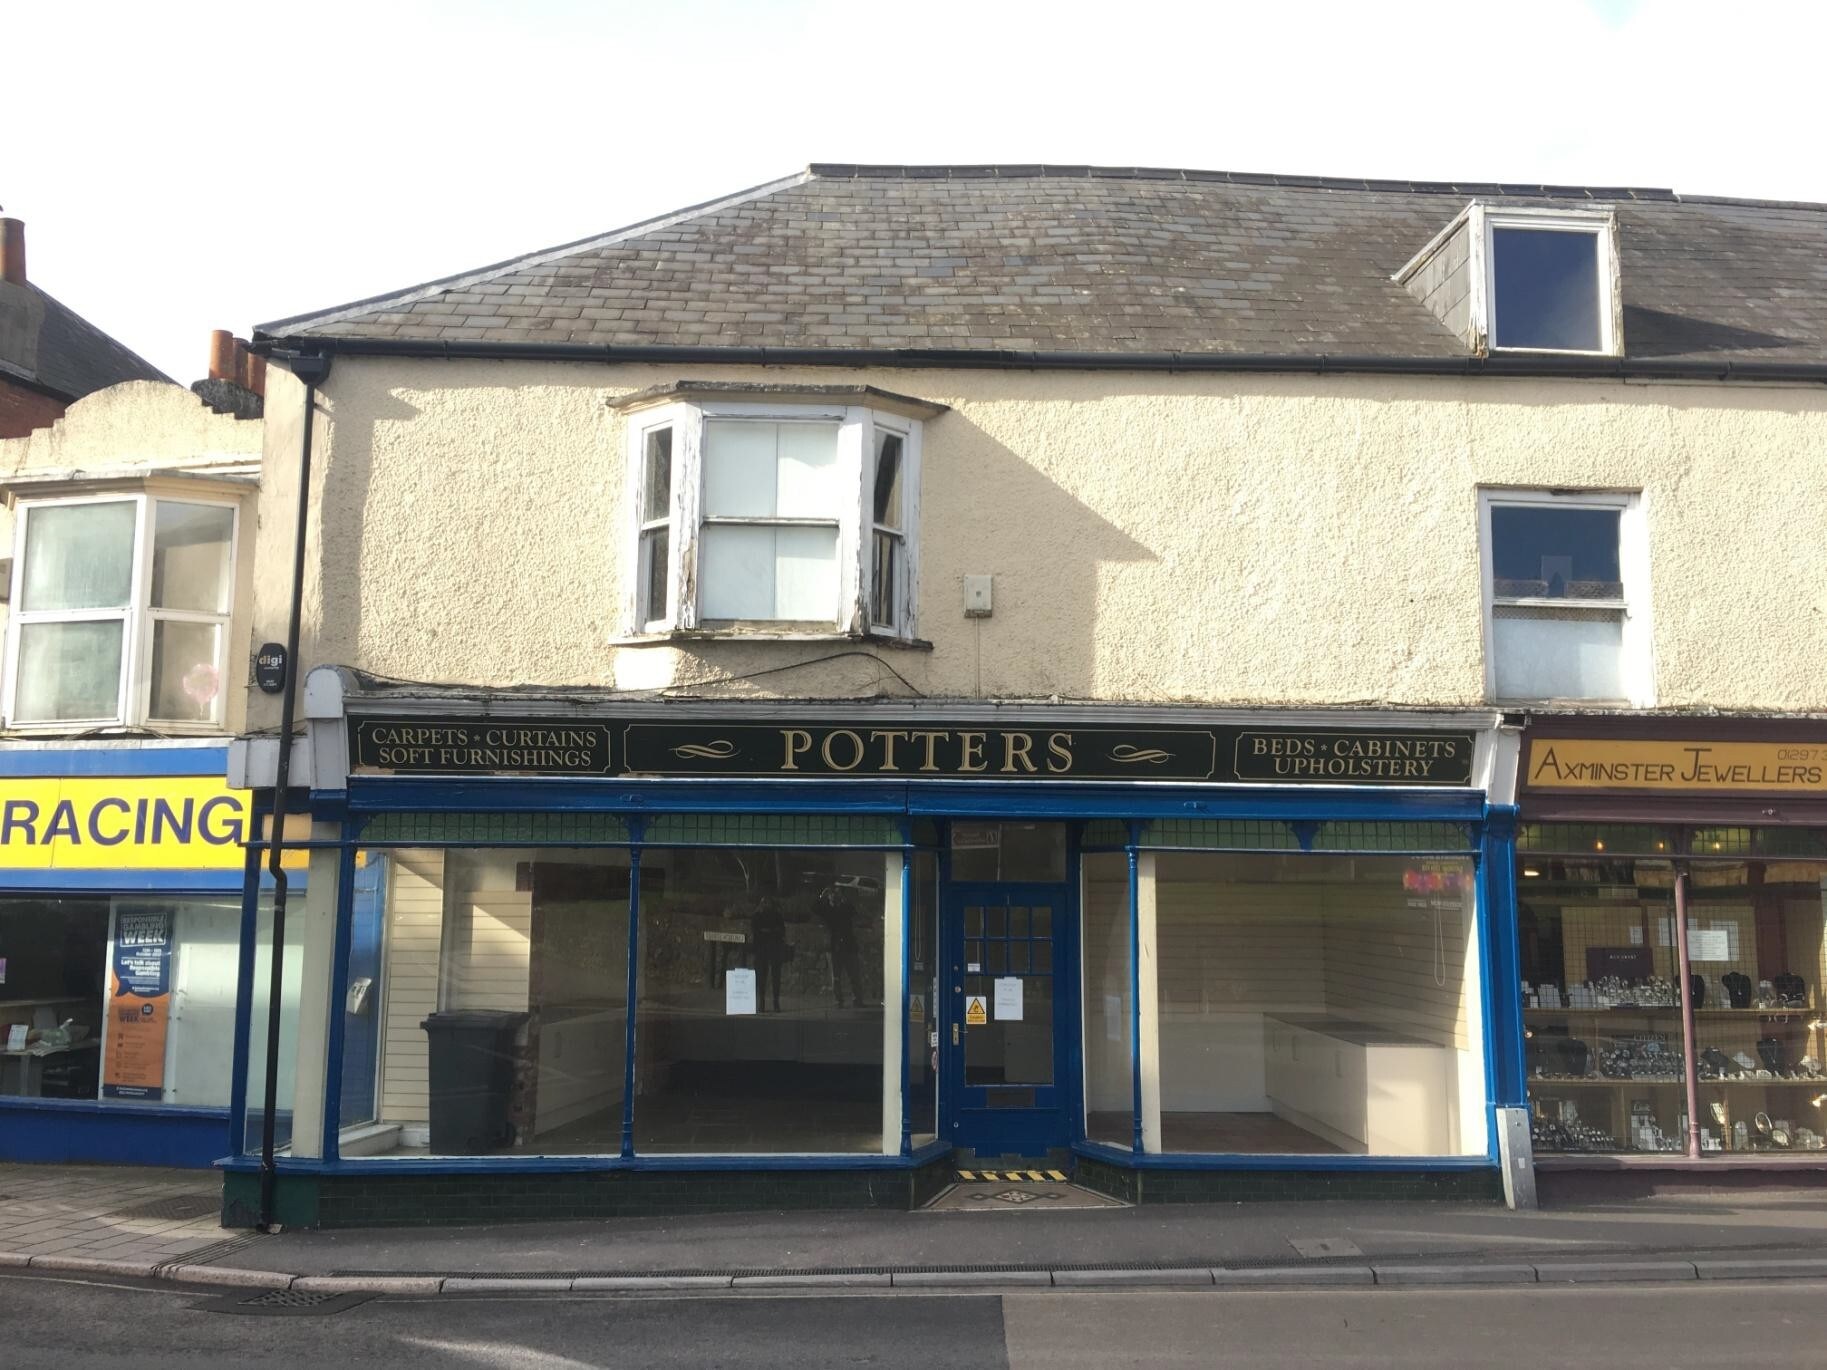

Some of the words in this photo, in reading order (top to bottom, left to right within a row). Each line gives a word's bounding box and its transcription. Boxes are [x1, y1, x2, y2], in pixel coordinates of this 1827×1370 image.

[258, 655, 283, 667] digi
[371, 728, 468, 745] CARPETS
[486, 730, 597, 747] CURTAINS
[379, 747, 434, 764] SOFT
[440, 749, 591, 766] FURNISHINGS
[779, 729, 1074, 773] POTTERS
[1252, 738, 1315, 755] BEDS
[1334, 739, 1456, 758] CABINETS
[1273, 758, 1434, 776] UPHOLSTERY
[0, 796, 244, 846] RACING
[123, 929, 164, 945] WEEK
